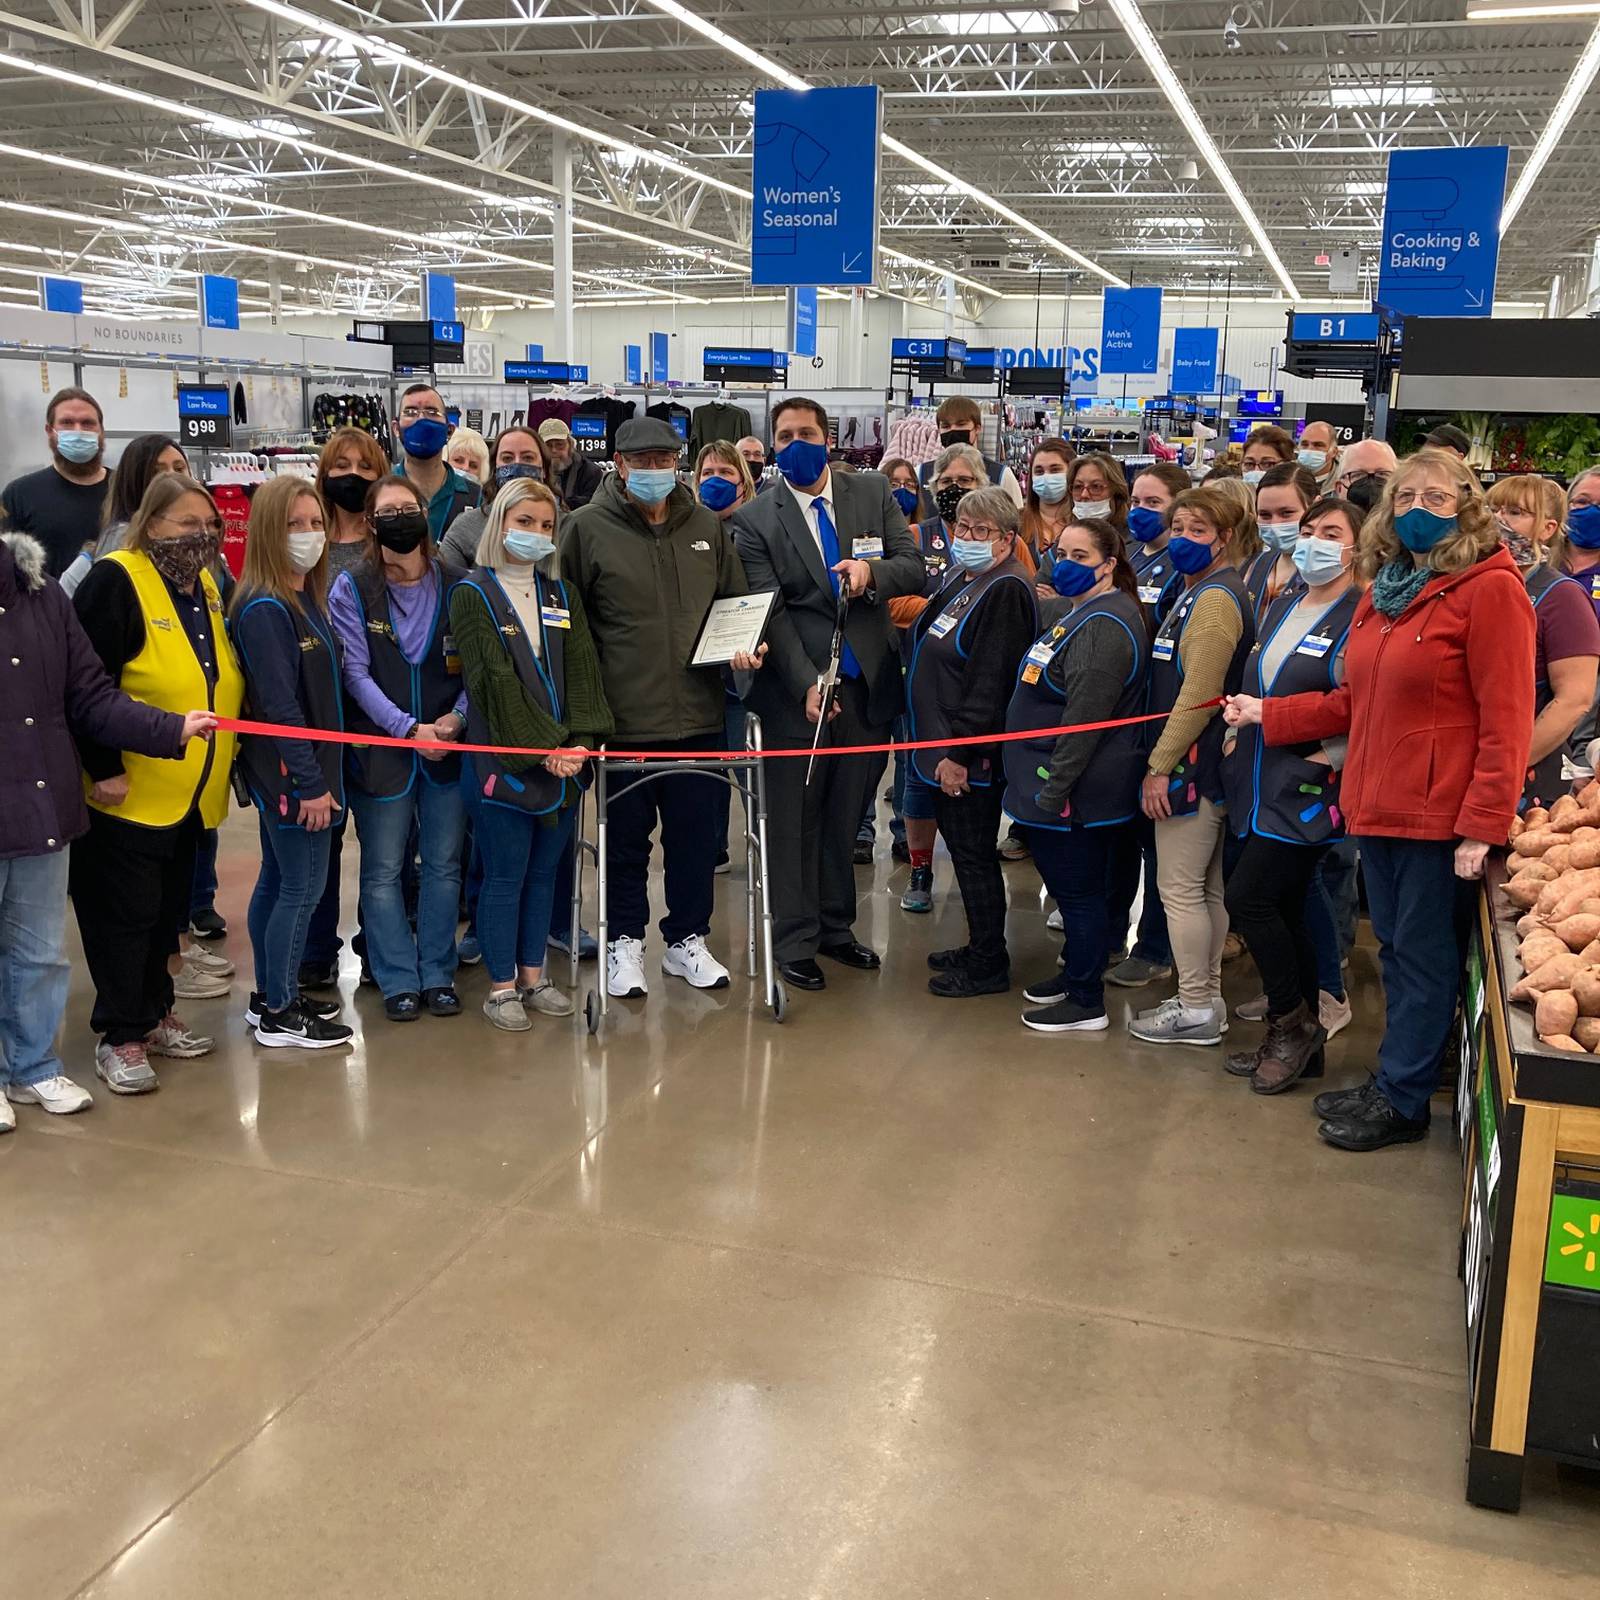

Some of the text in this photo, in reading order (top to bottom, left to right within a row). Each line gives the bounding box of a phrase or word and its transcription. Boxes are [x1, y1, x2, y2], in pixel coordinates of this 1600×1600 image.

[763, 186, 841, 205] Women's
[763, 208, 838, 227] Seasonal
[1391, 231, 1480, 252] Cooking &
[1390, 252, 1446, 271] Baking
[94, 327, 183, 344] NO BOUNDARIES
[1107, 330, 1131, 338] Men's
[1105, 340, 1133, 348] Active
[201, 401, 218, 409] Price
